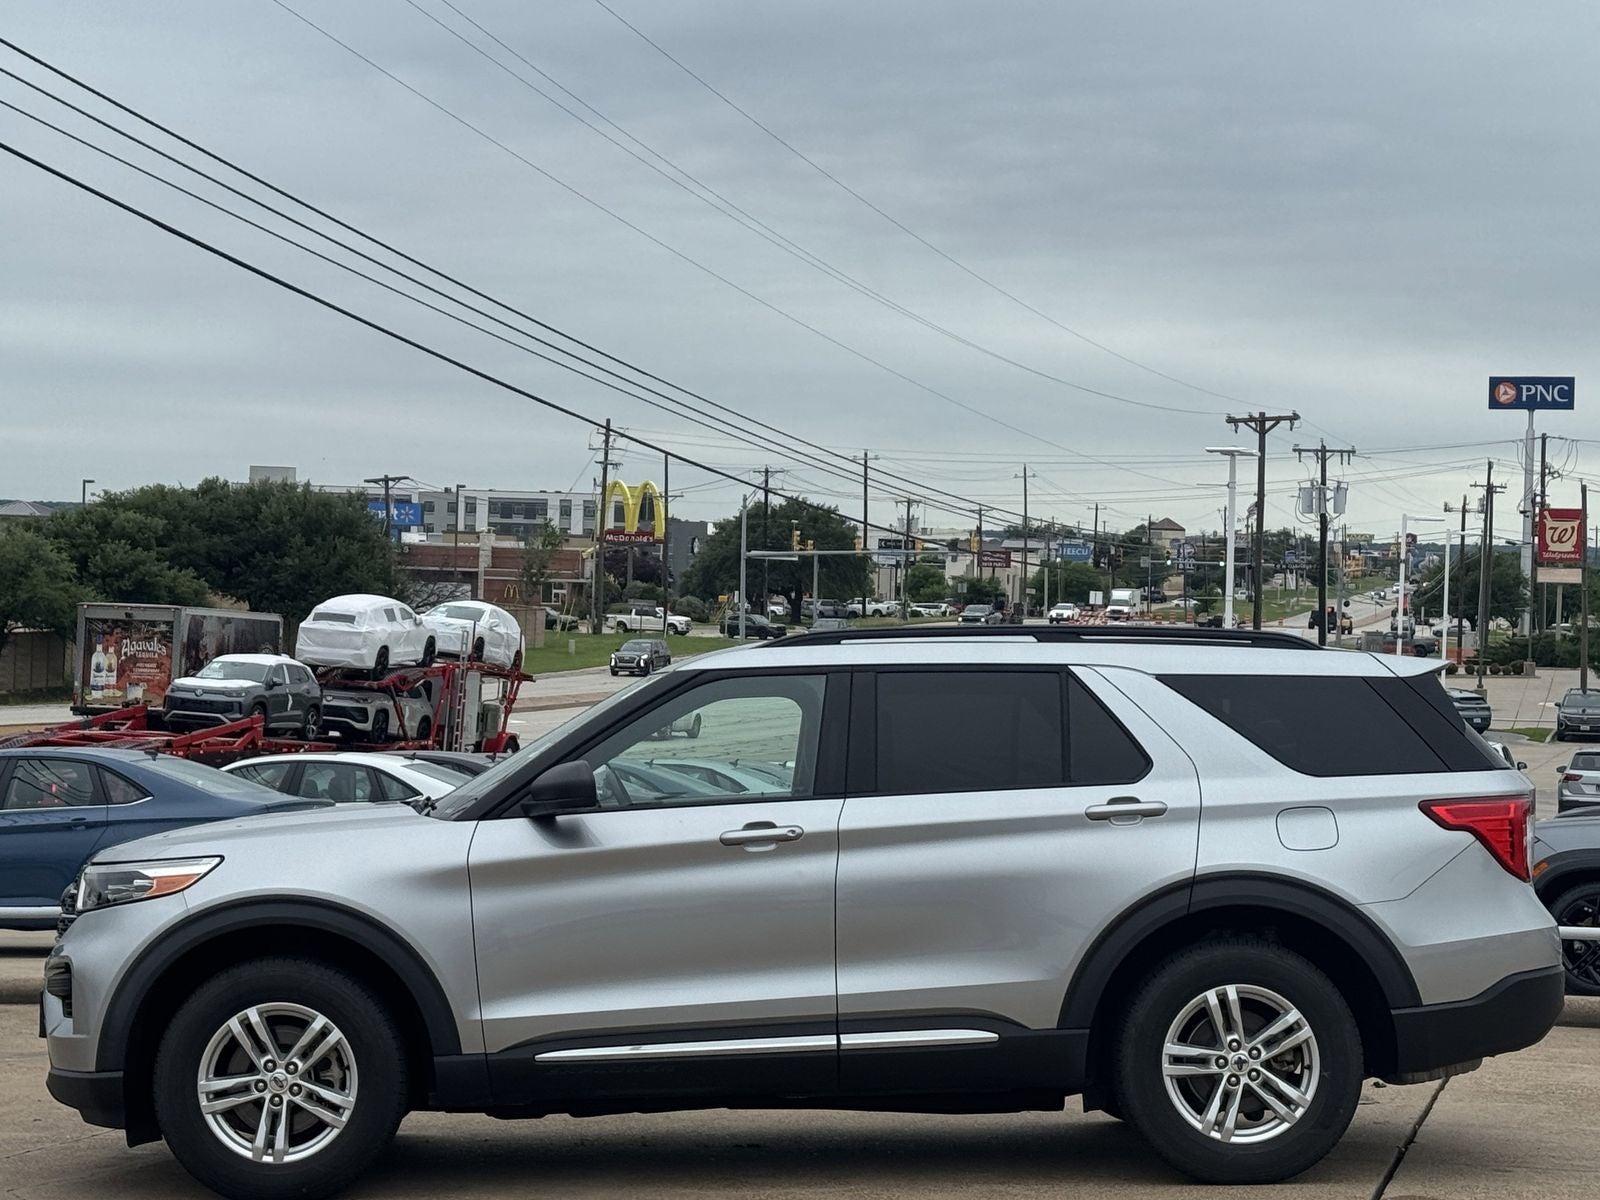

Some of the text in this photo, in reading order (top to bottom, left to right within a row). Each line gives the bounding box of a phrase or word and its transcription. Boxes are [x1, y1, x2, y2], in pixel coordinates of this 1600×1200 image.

[1520, 384, 1569, 402] PNC
[605, 534, 654, 542] McDonald's
[1542, 551, 1581, 560] Walgreens
[119, 637, 167, 663] Agavales
[135, 651, 159, 659] TEQUILA
